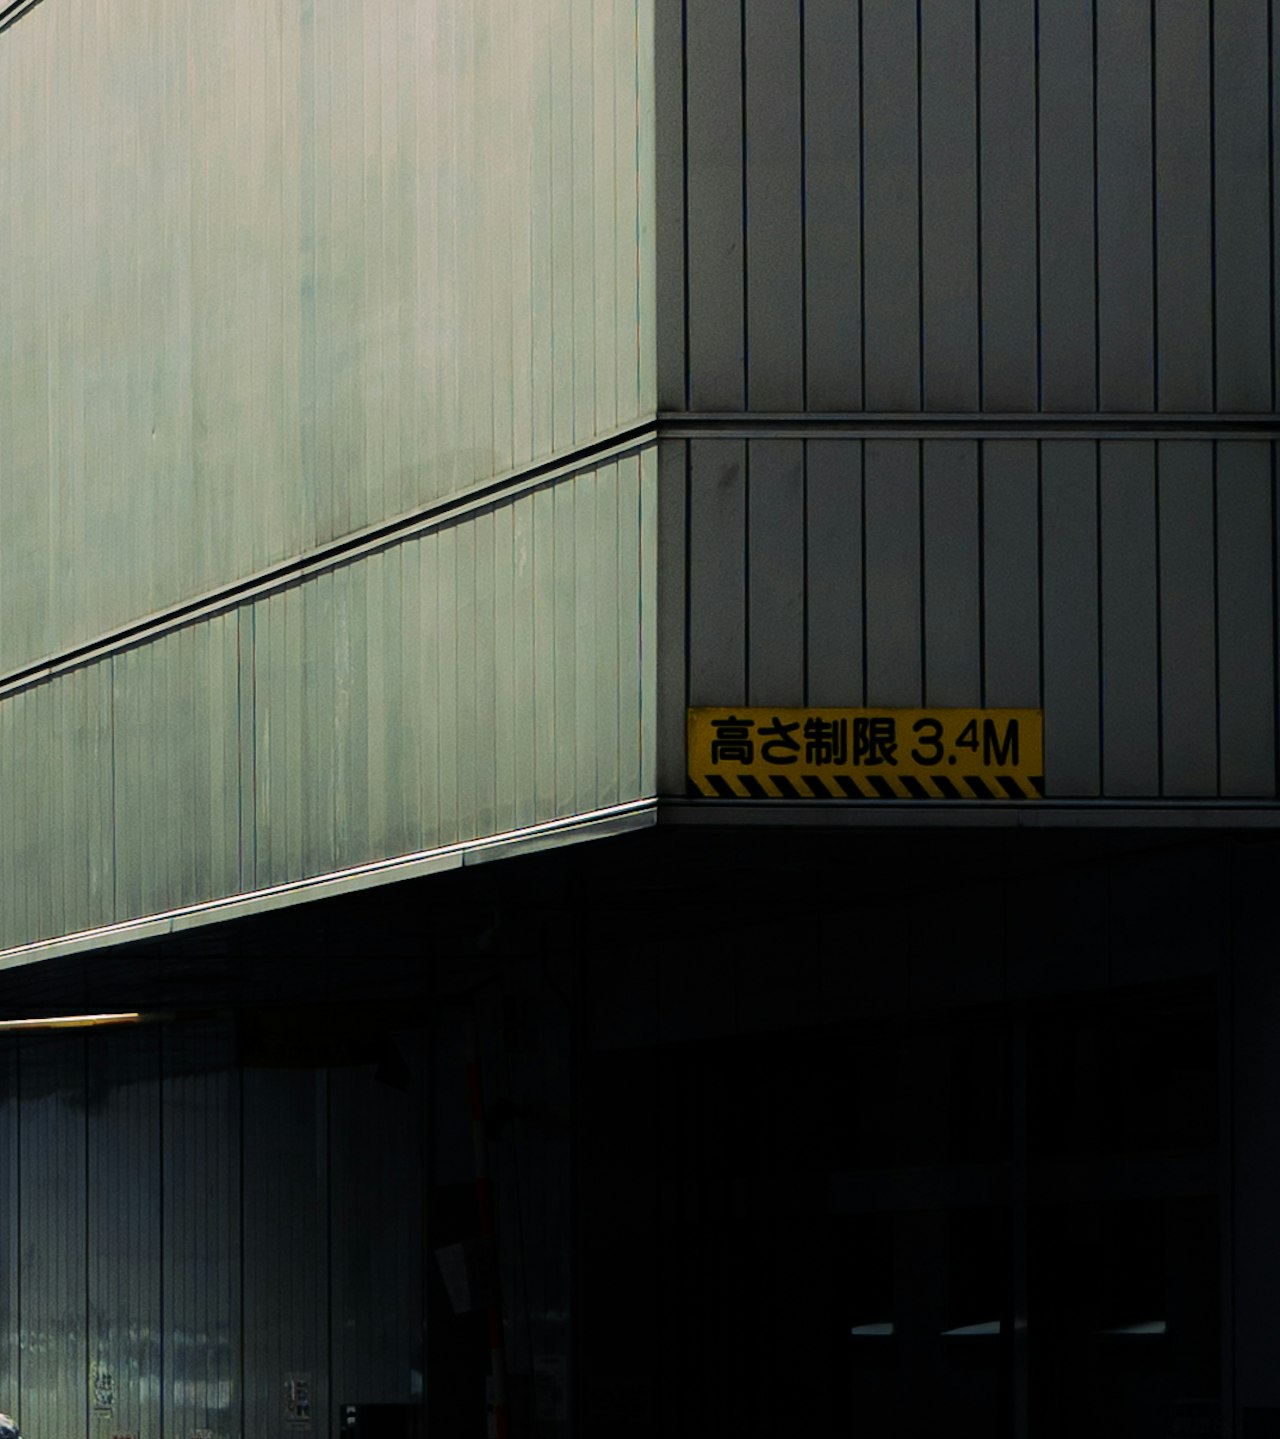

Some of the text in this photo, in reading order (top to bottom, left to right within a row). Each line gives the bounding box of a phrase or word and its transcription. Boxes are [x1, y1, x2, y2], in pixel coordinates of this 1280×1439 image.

[711, 715, 1019, 767] 高さ制限 3.4M
